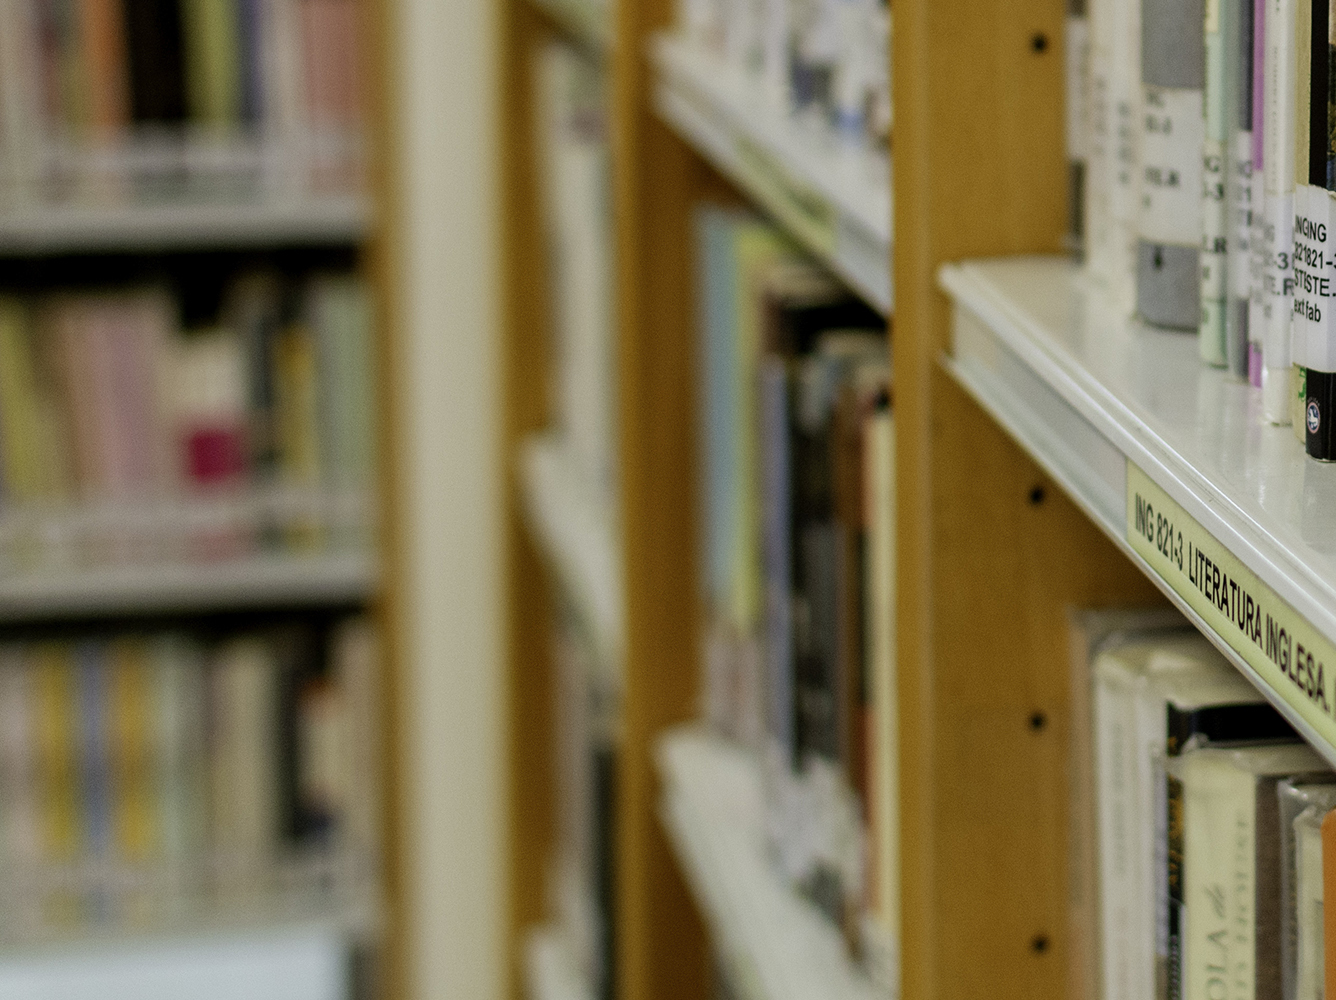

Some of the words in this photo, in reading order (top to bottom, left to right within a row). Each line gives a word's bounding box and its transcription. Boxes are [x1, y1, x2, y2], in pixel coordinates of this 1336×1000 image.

[1307, 220, 1327, 243] ING
[1305, 300, 1321, 323] fab
[1134, 493, 1155, 542] ING
[1156, 512, 1184, 572] 821-3
[1188, 540, 1264, 651] LITERATURA
